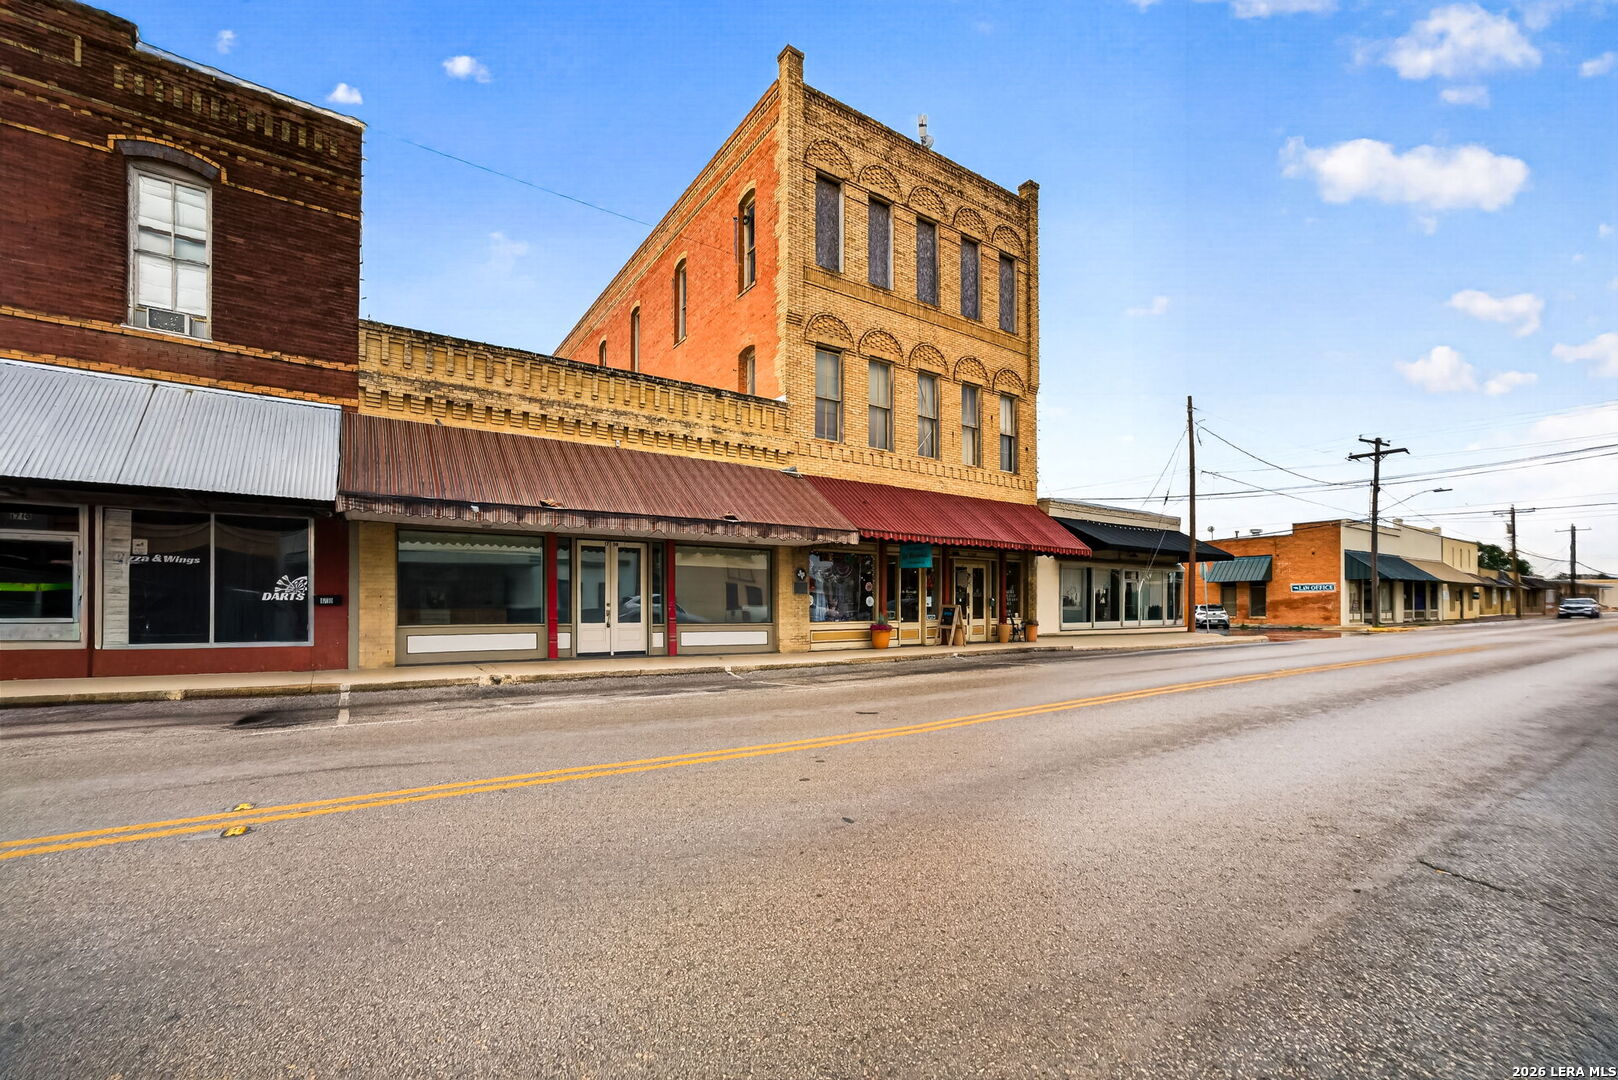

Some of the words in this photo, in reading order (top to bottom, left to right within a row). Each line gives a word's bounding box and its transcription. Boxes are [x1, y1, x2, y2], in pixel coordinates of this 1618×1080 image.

[152, 554, 162, 562] &
[163, 555, 200, 564] Wings
[261, 592, 305, 601] DARTS
